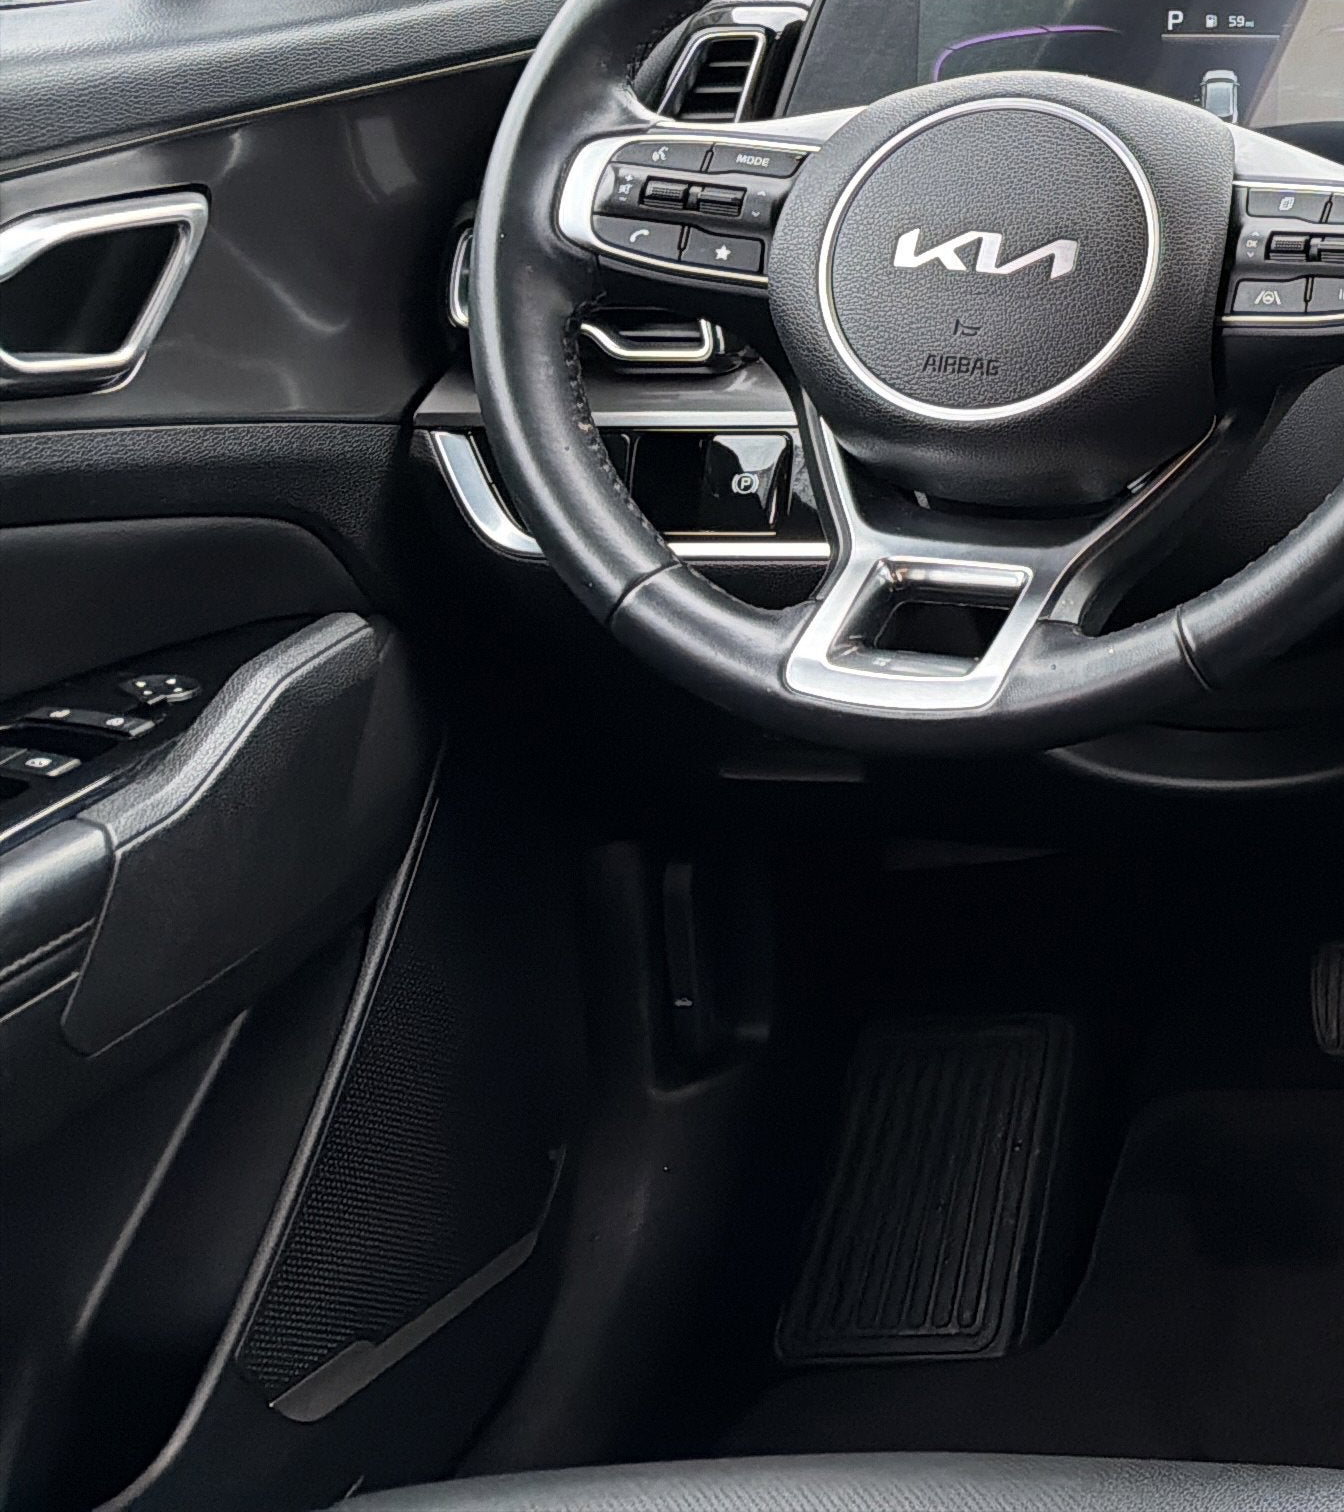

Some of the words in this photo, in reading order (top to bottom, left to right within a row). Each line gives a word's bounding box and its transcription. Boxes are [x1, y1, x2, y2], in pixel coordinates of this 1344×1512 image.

[1167, 10, 1184, 31] P
[735, 154, 770, 168] MODE
[921, 354, 1001, 377] AIRBAG
